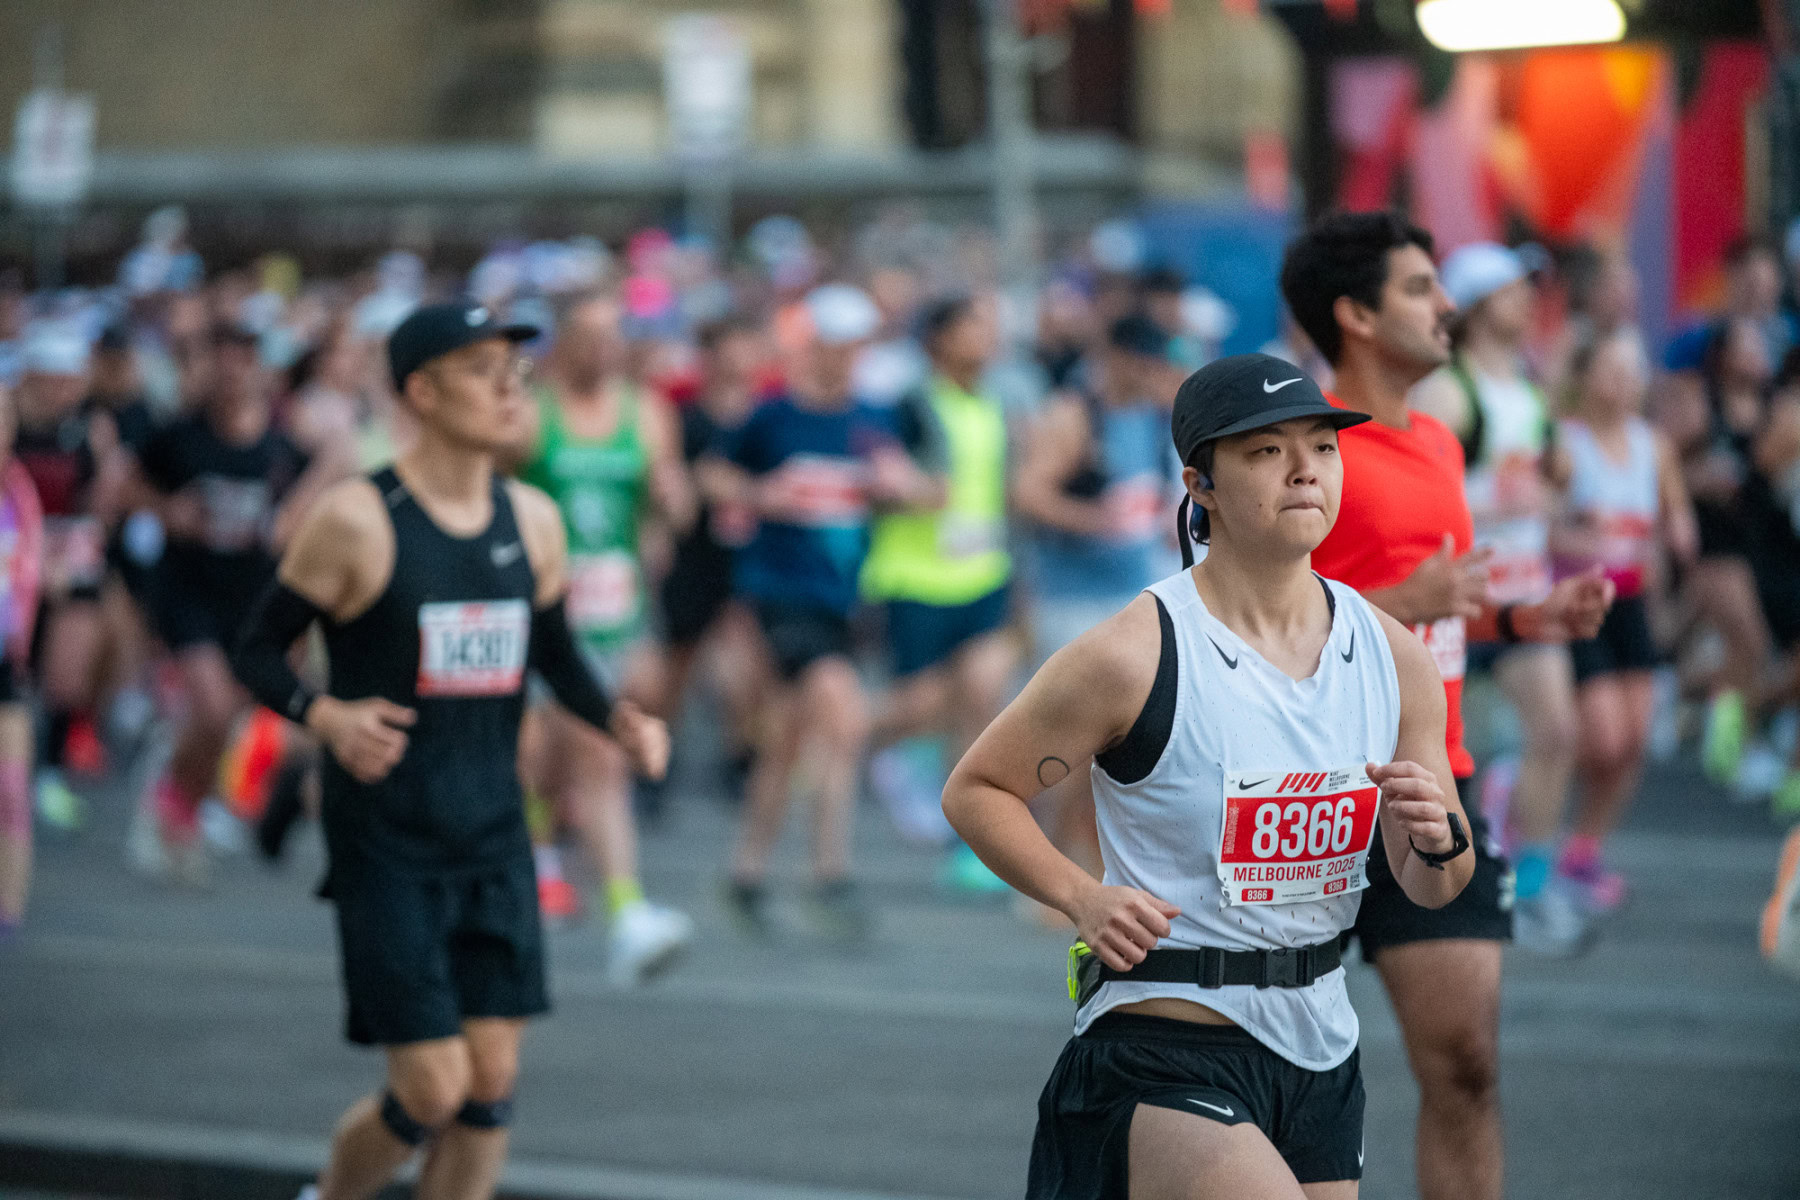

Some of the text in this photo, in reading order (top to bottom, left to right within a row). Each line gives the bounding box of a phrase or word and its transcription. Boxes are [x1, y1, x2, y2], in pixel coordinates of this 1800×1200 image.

[1252, 797, 1356, 859] 8366
[1233, 857, 1356, 882] MELBOURNE 2025
[1247, 890, 1268, 901] 8366
[1327, 880, 1344, 893] 8366
